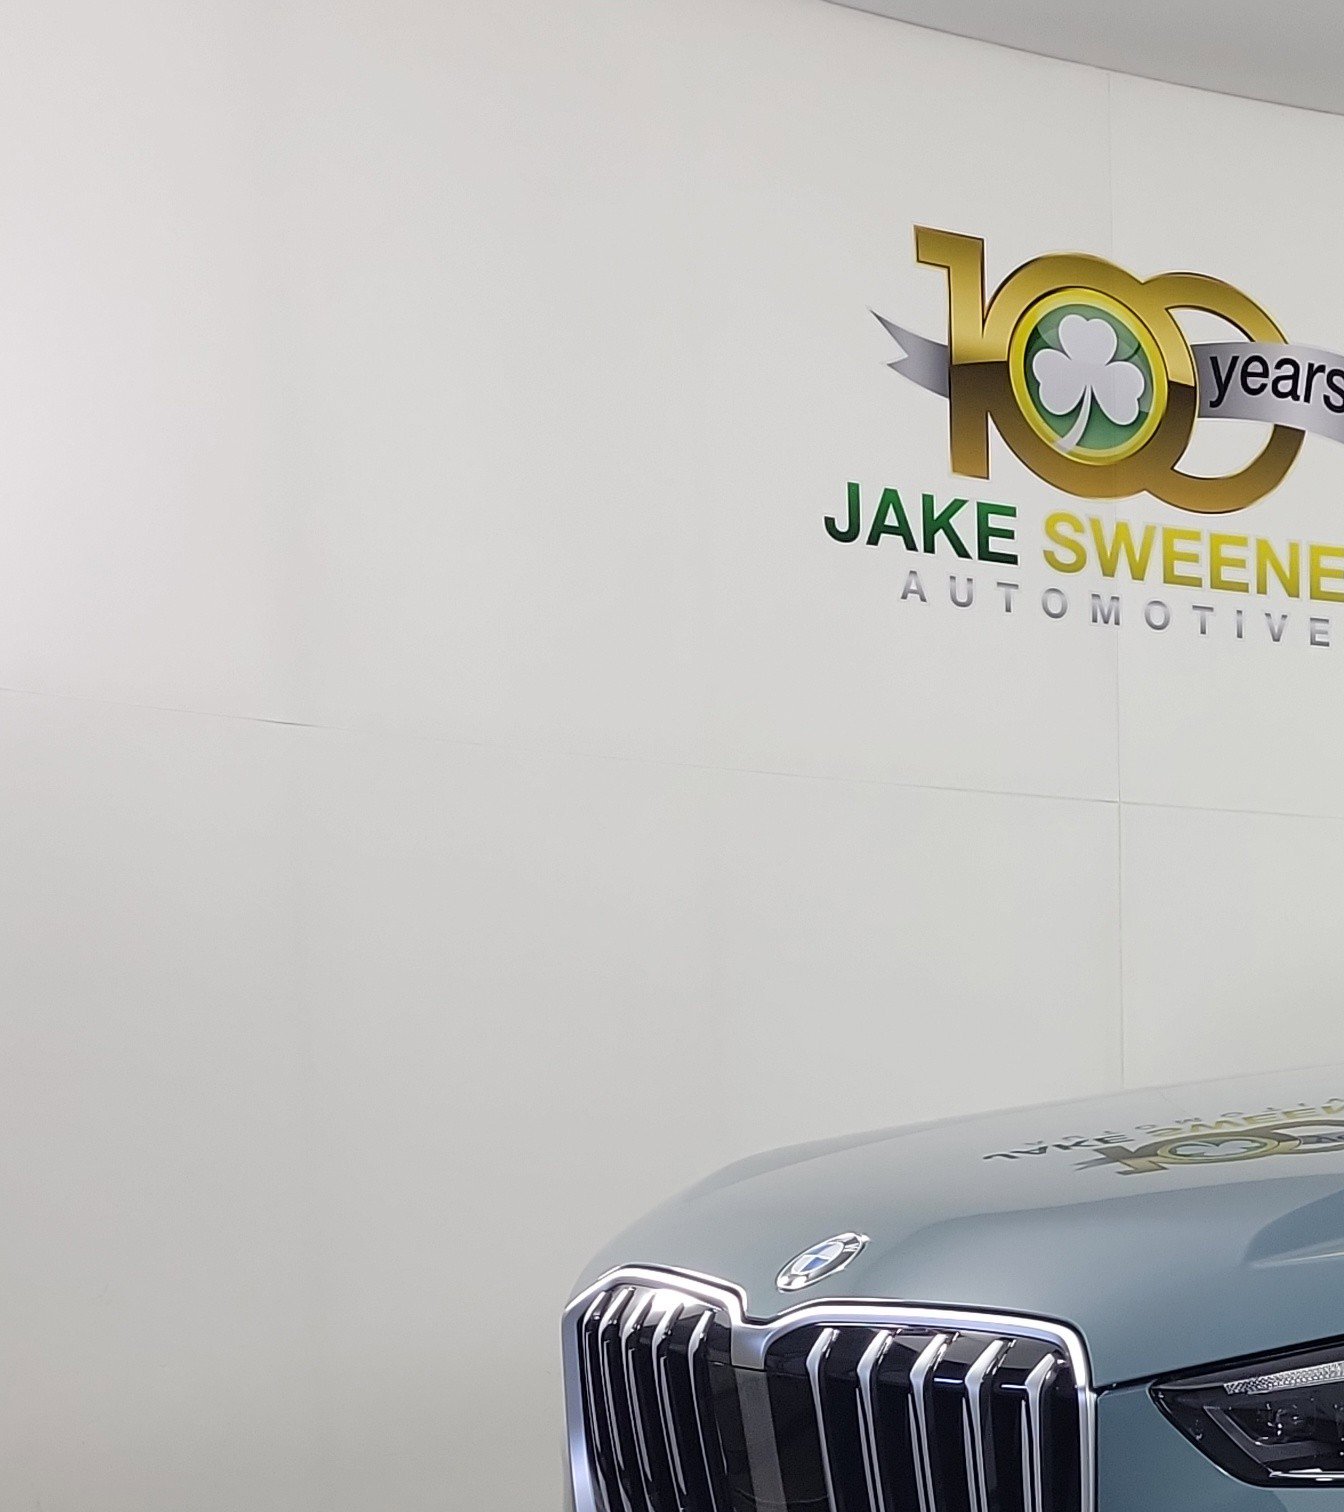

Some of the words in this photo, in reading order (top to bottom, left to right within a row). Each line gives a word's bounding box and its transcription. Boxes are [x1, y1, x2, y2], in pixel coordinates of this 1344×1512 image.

[914, 224, 1304, 514] 100
[824, 481, 1019, 566] JAKE
[900, 569, 1331, 647] AUTOMOTIVE
